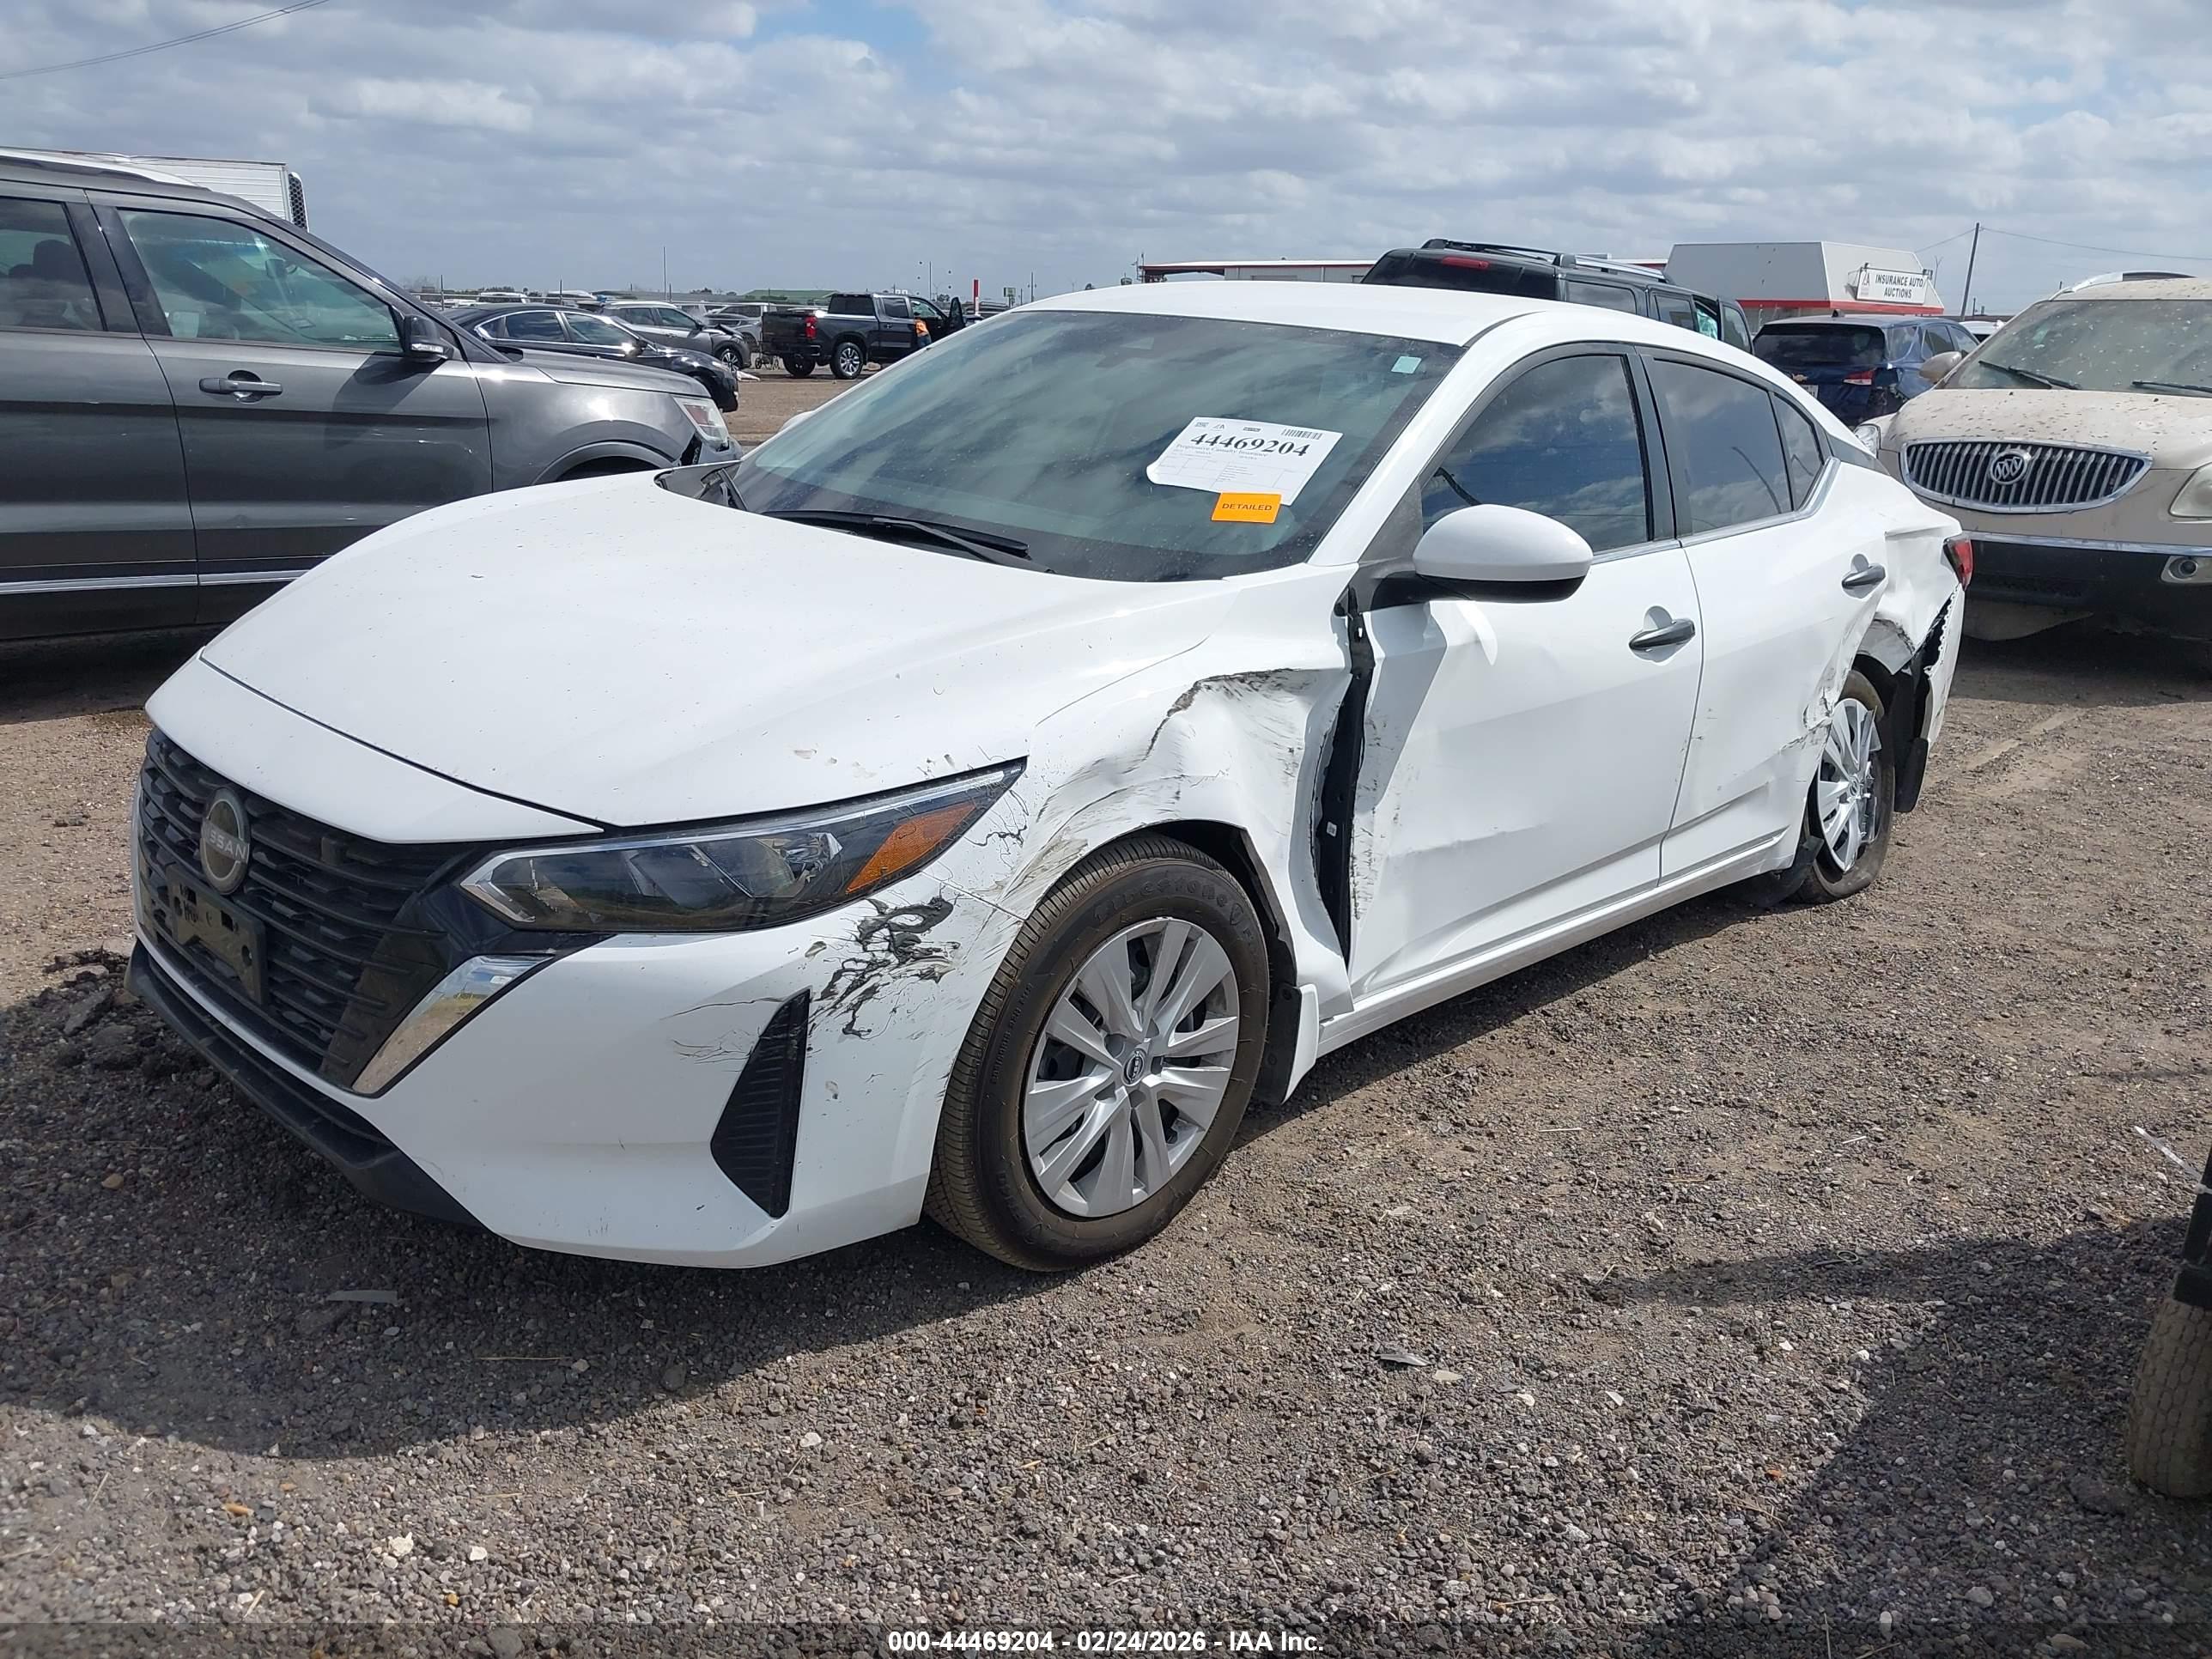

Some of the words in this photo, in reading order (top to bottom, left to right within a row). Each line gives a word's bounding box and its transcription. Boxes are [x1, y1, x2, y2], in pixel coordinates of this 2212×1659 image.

[1875, 275, 1908, 286] INSURANCE
[1909, 277, 1923, 288] AUTO
[1883, 288, 1912, 298] AUCTIONS
[1190, 433, 1311, 457] 44469204
[1222, 502, 1273, 511] DETAILED
